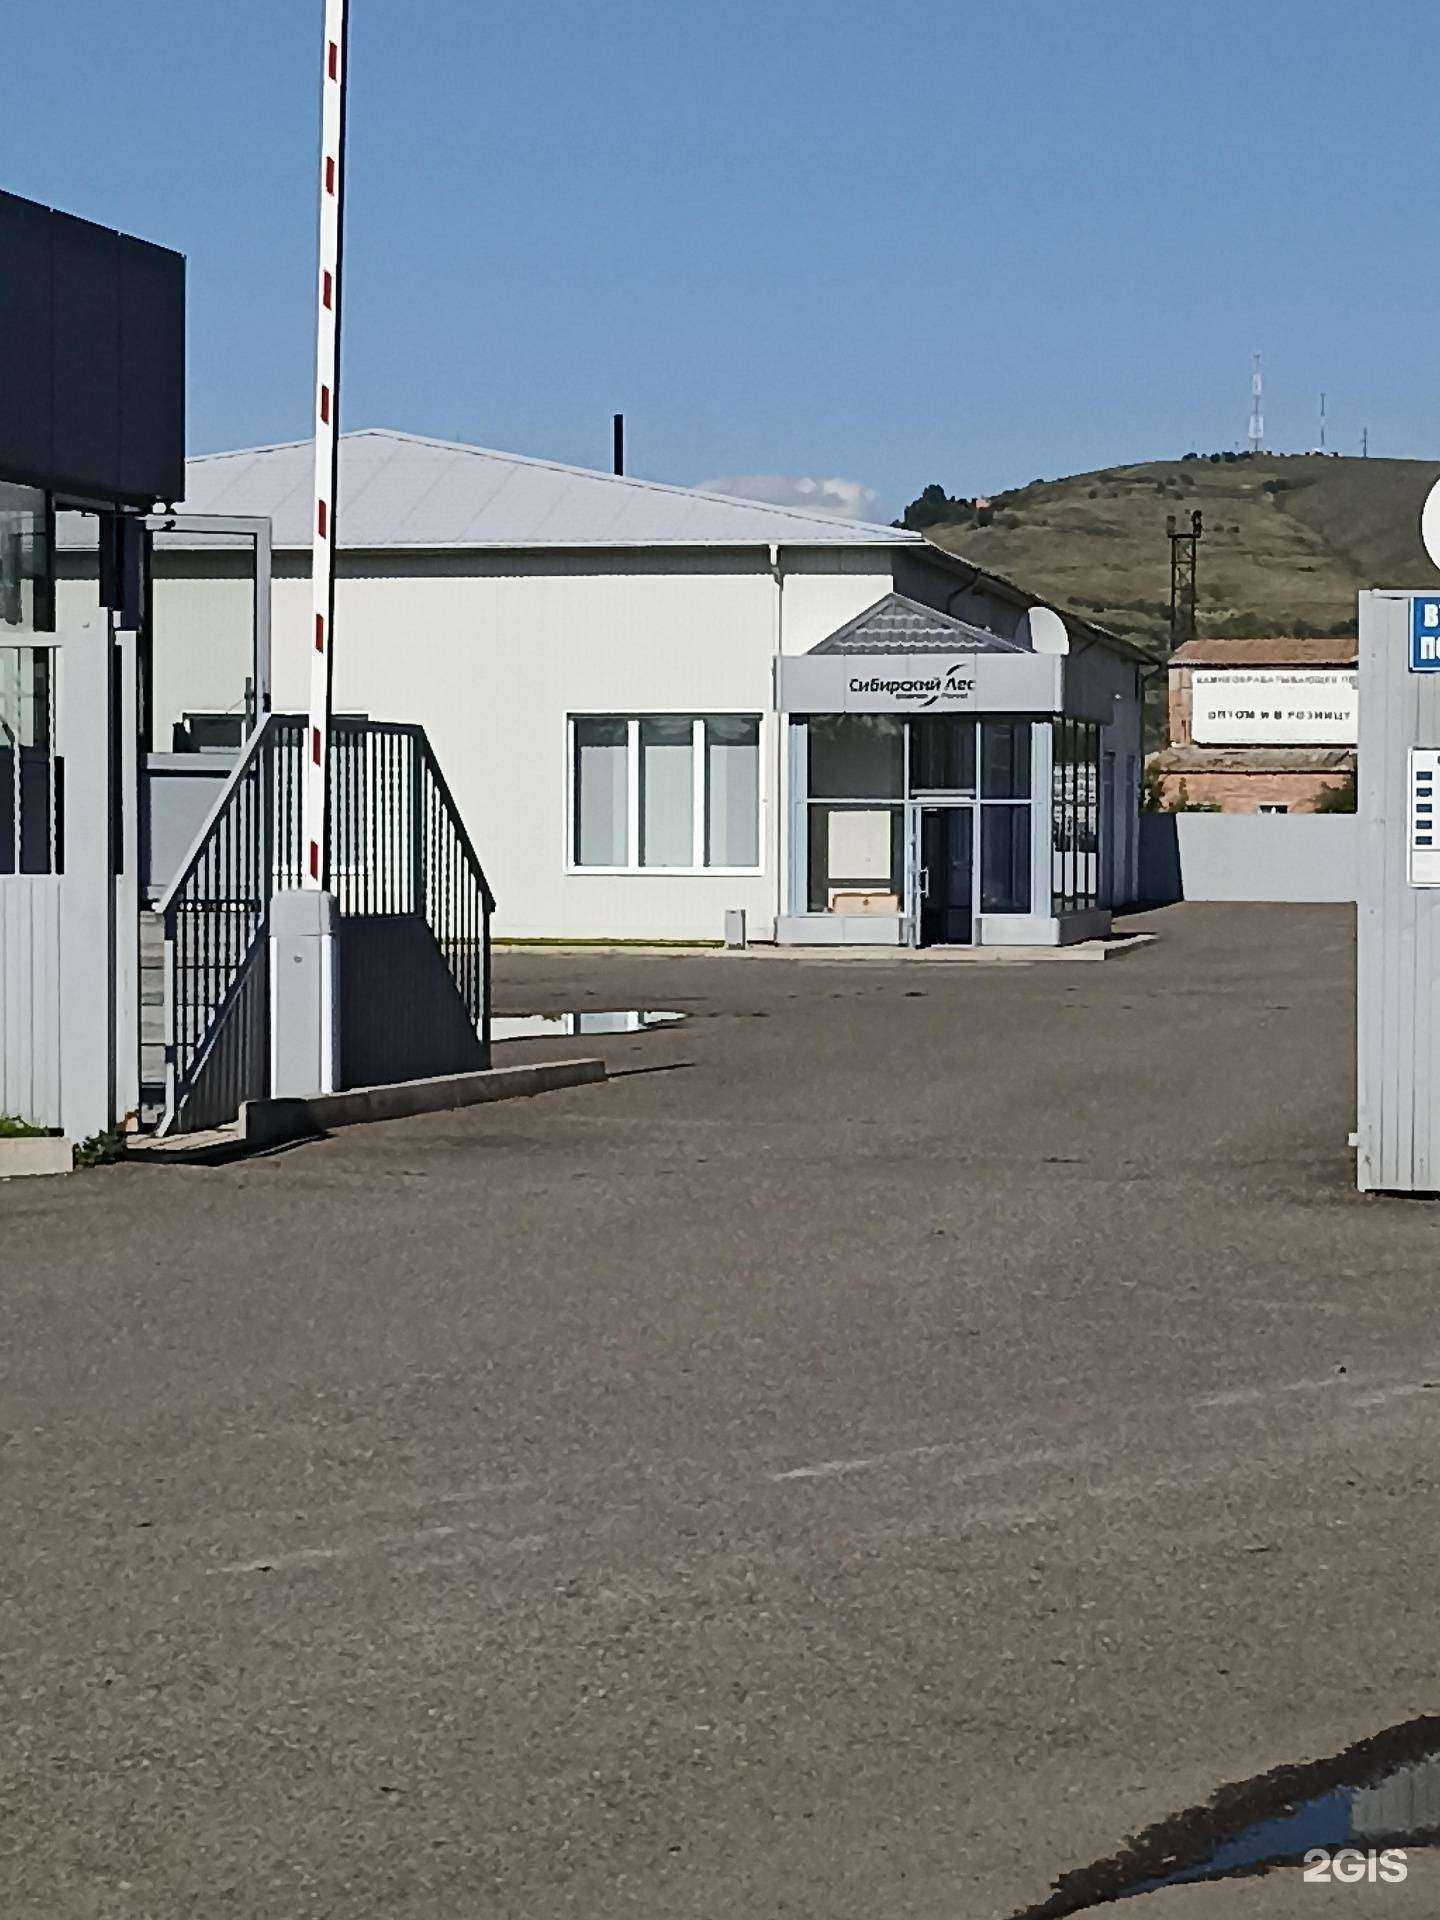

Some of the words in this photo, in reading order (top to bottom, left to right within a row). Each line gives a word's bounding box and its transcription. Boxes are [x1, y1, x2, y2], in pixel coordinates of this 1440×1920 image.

[849, 678, 941, 694] Сибирский
[945, 677, 976, 691] Лес
[1208, 710, 1255, 720] ОПТОМ
[1287, 710, 1350, 720] РОЗНИЦУ
